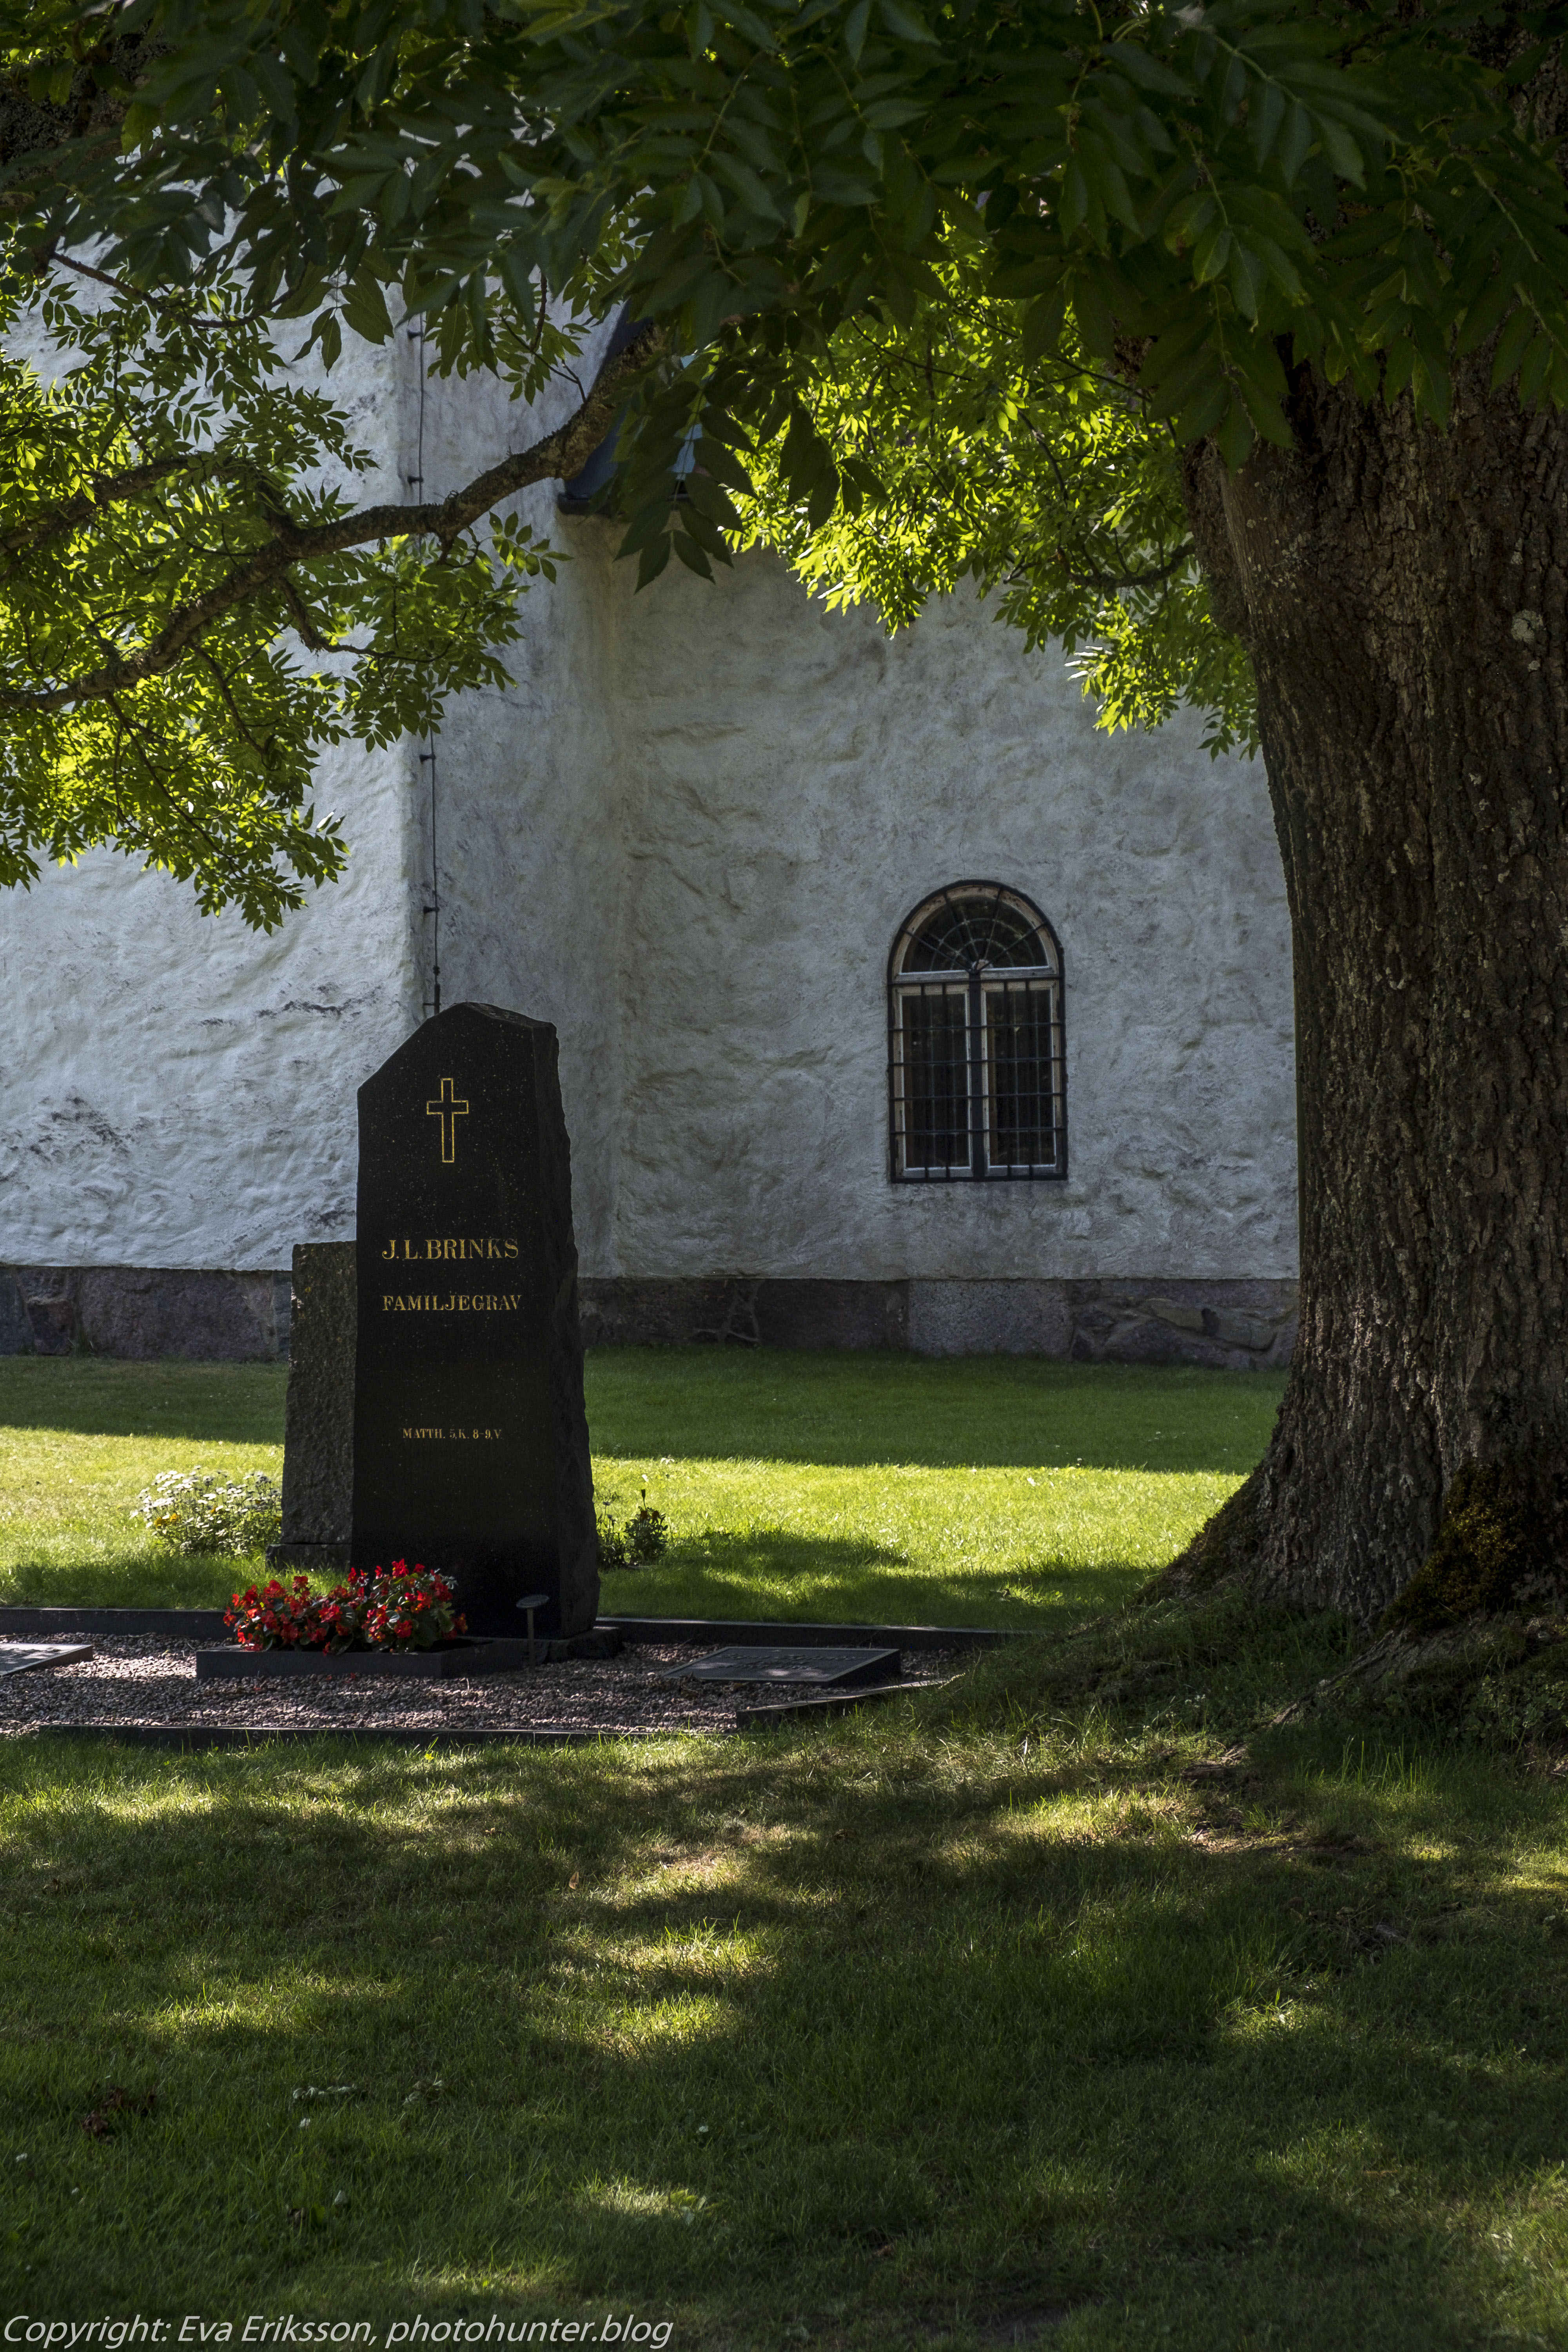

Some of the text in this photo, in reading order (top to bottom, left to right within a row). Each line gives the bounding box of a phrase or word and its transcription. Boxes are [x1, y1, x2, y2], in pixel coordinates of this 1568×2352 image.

[425, 1238, 518, 1259] BRINKS
[382, 1295, 521, 1311] FAMILJEGRAV
[403, 1428, 445, 1439] MATTH.
